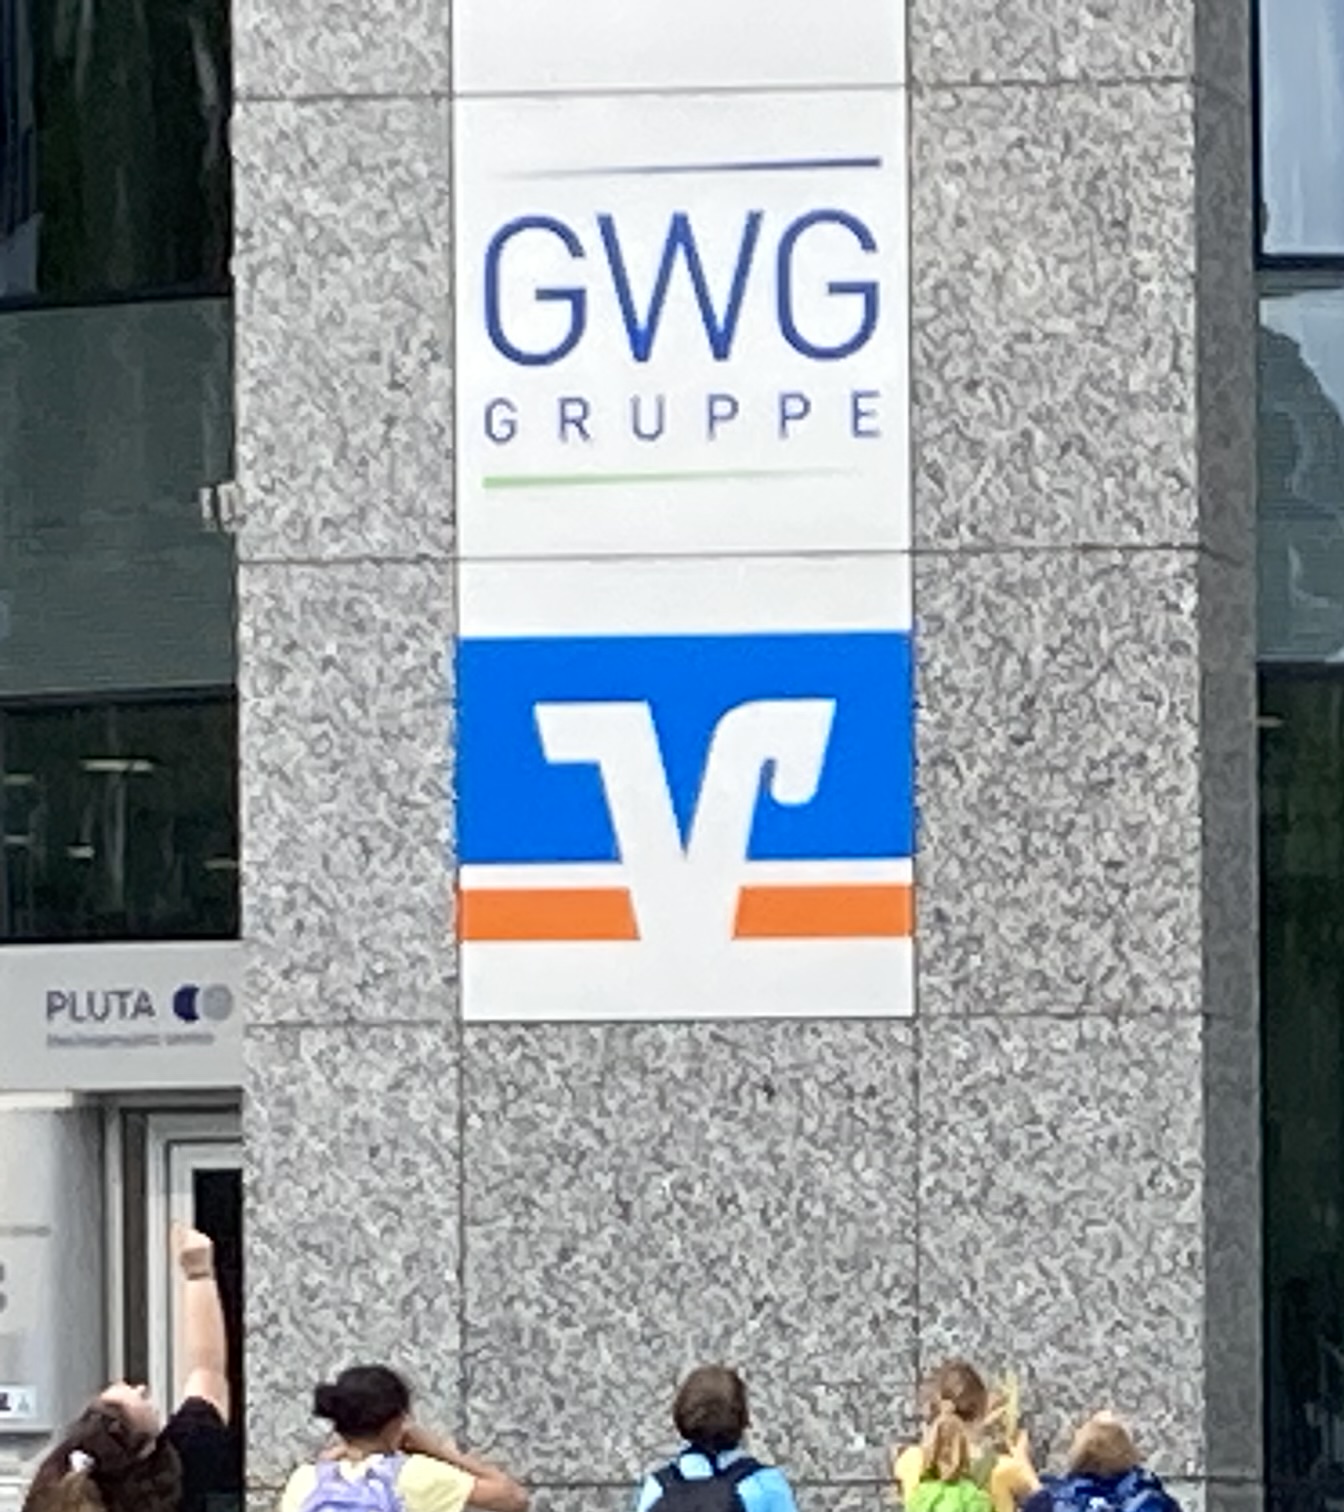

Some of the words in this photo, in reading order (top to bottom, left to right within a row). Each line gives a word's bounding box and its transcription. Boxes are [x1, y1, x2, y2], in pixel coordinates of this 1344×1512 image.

[484, 208, 880, 367] GWG
[484, 389, 881, 446] GRUPPE
[46, 989, 156, 1023] PLUTA
